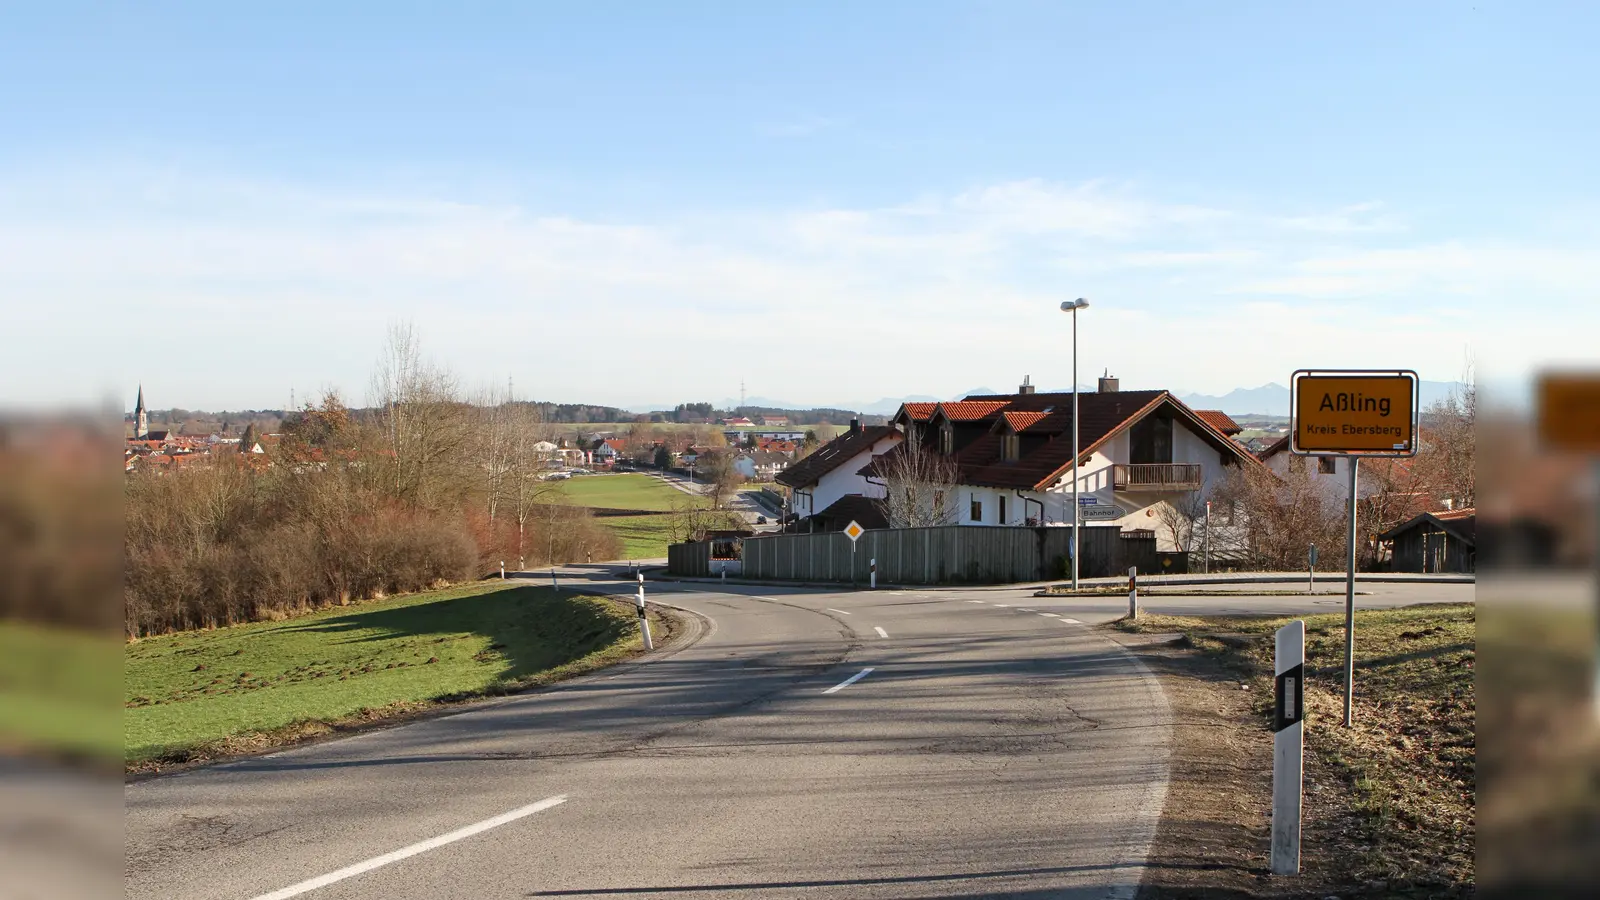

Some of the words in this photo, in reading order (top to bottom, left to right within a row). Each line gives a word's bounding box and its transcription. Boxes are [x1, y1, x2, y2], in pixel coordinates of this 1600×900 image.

[1319, 393, 1391, 417] Aßling
[1307, 424, 1337, 435] Kreis
[1342, 424, 1402, 437] Ebersberg
